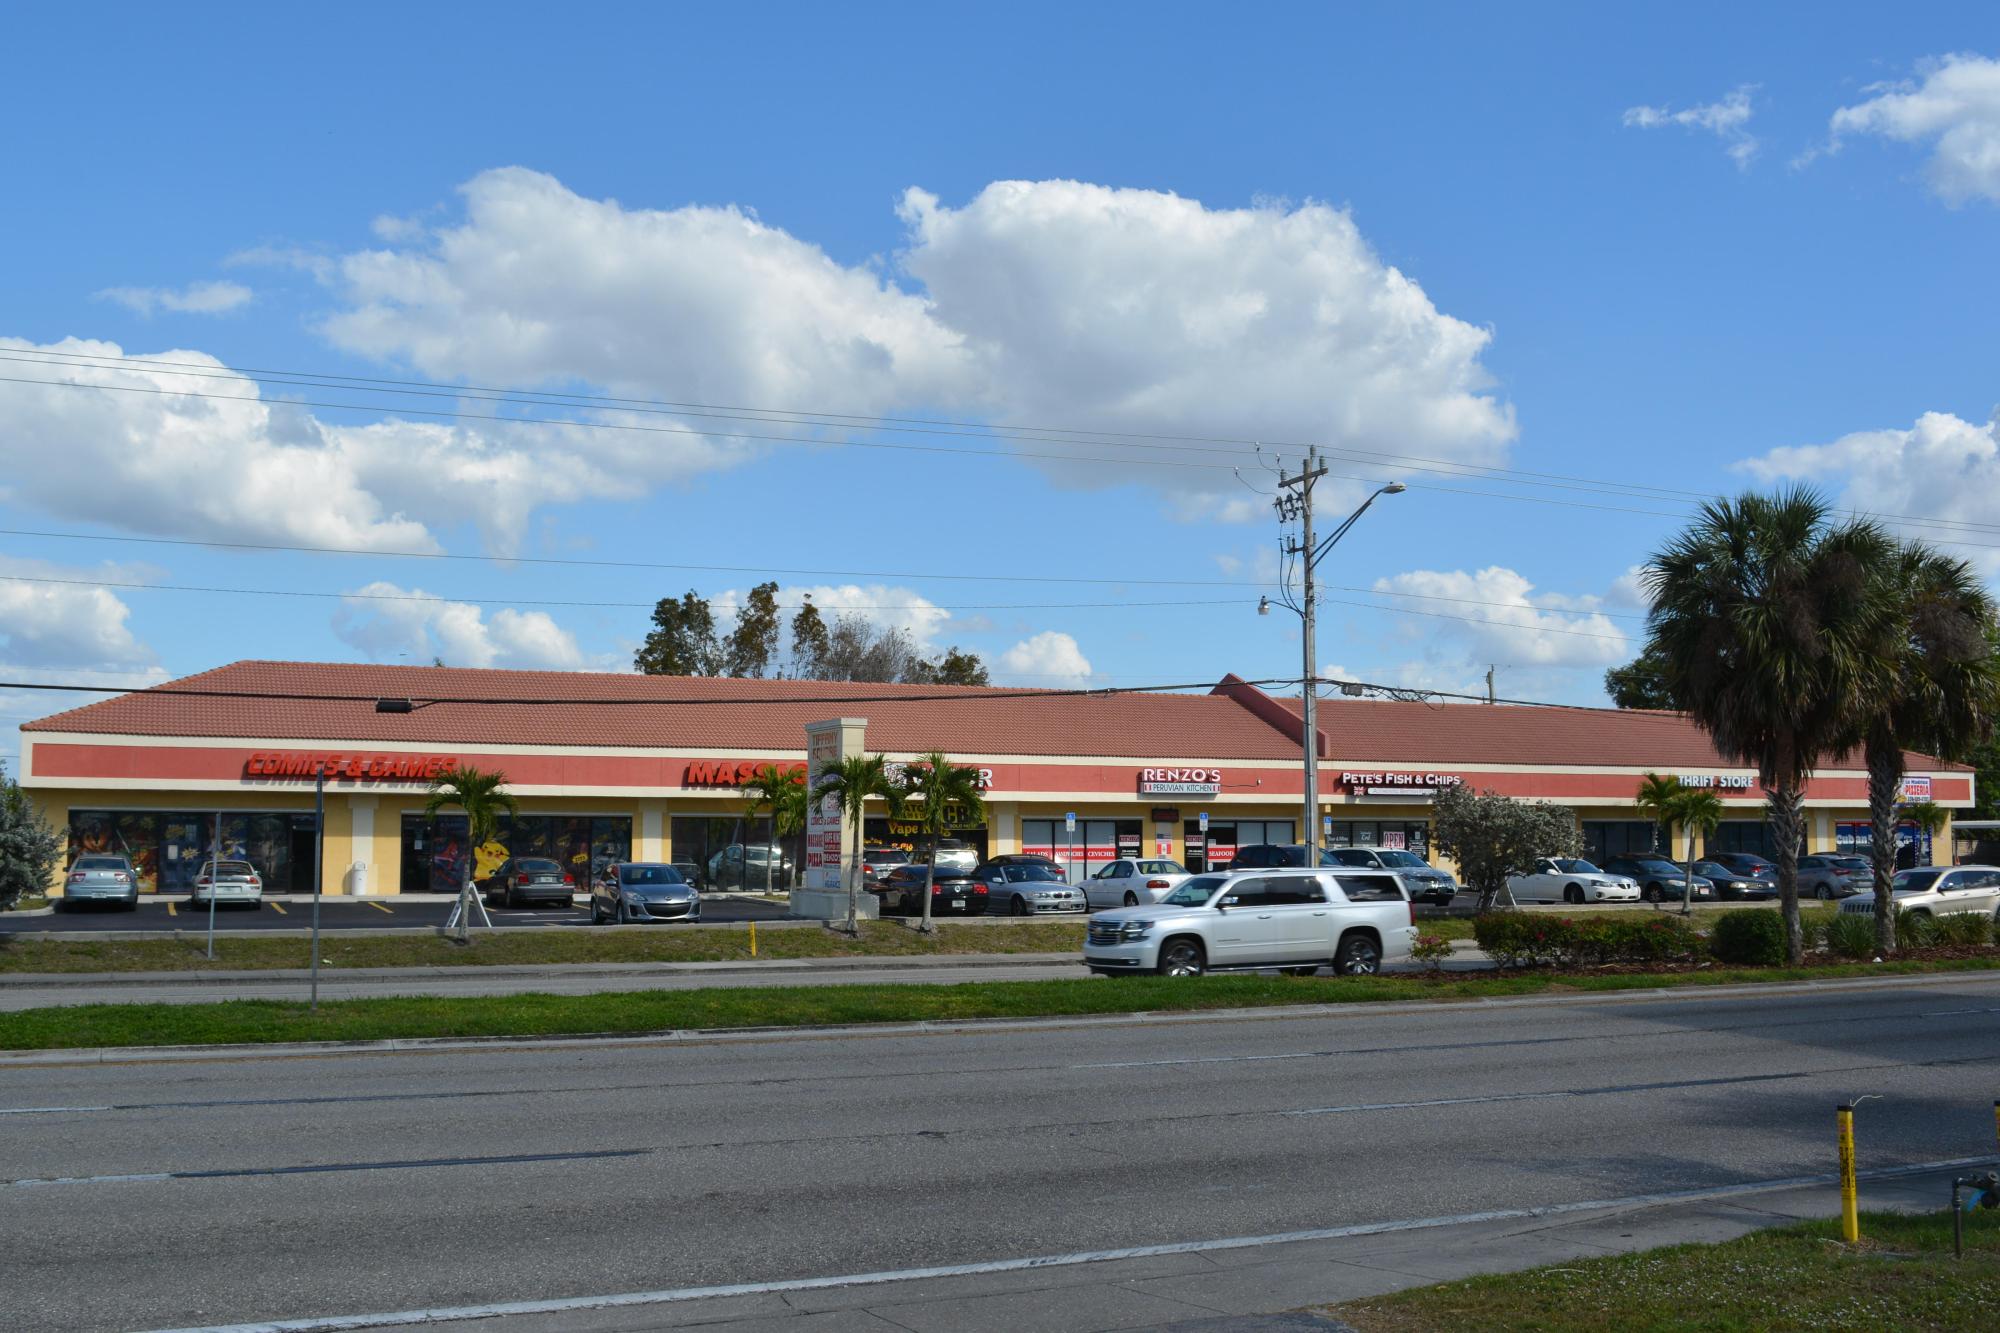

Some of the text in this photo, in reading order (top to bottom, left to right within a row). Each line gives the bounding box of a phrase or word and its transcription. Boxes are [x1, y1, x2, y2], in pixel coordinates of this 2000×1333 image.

[247, 753, 458, 778] COMICS & GAMES
[1143, 768, 1221, 783] RENZO'S
[1342, 772, 1460, 785] PETE'S FISH & CHIPS
[1678, 775, 1754, 788] THRIFT STORE
[1152, 783, 1212, 792] PERUVIAN KITCHEN
[887, 822, 919, 836] Vape
[1384, 832, 1404, 847] OPEN
